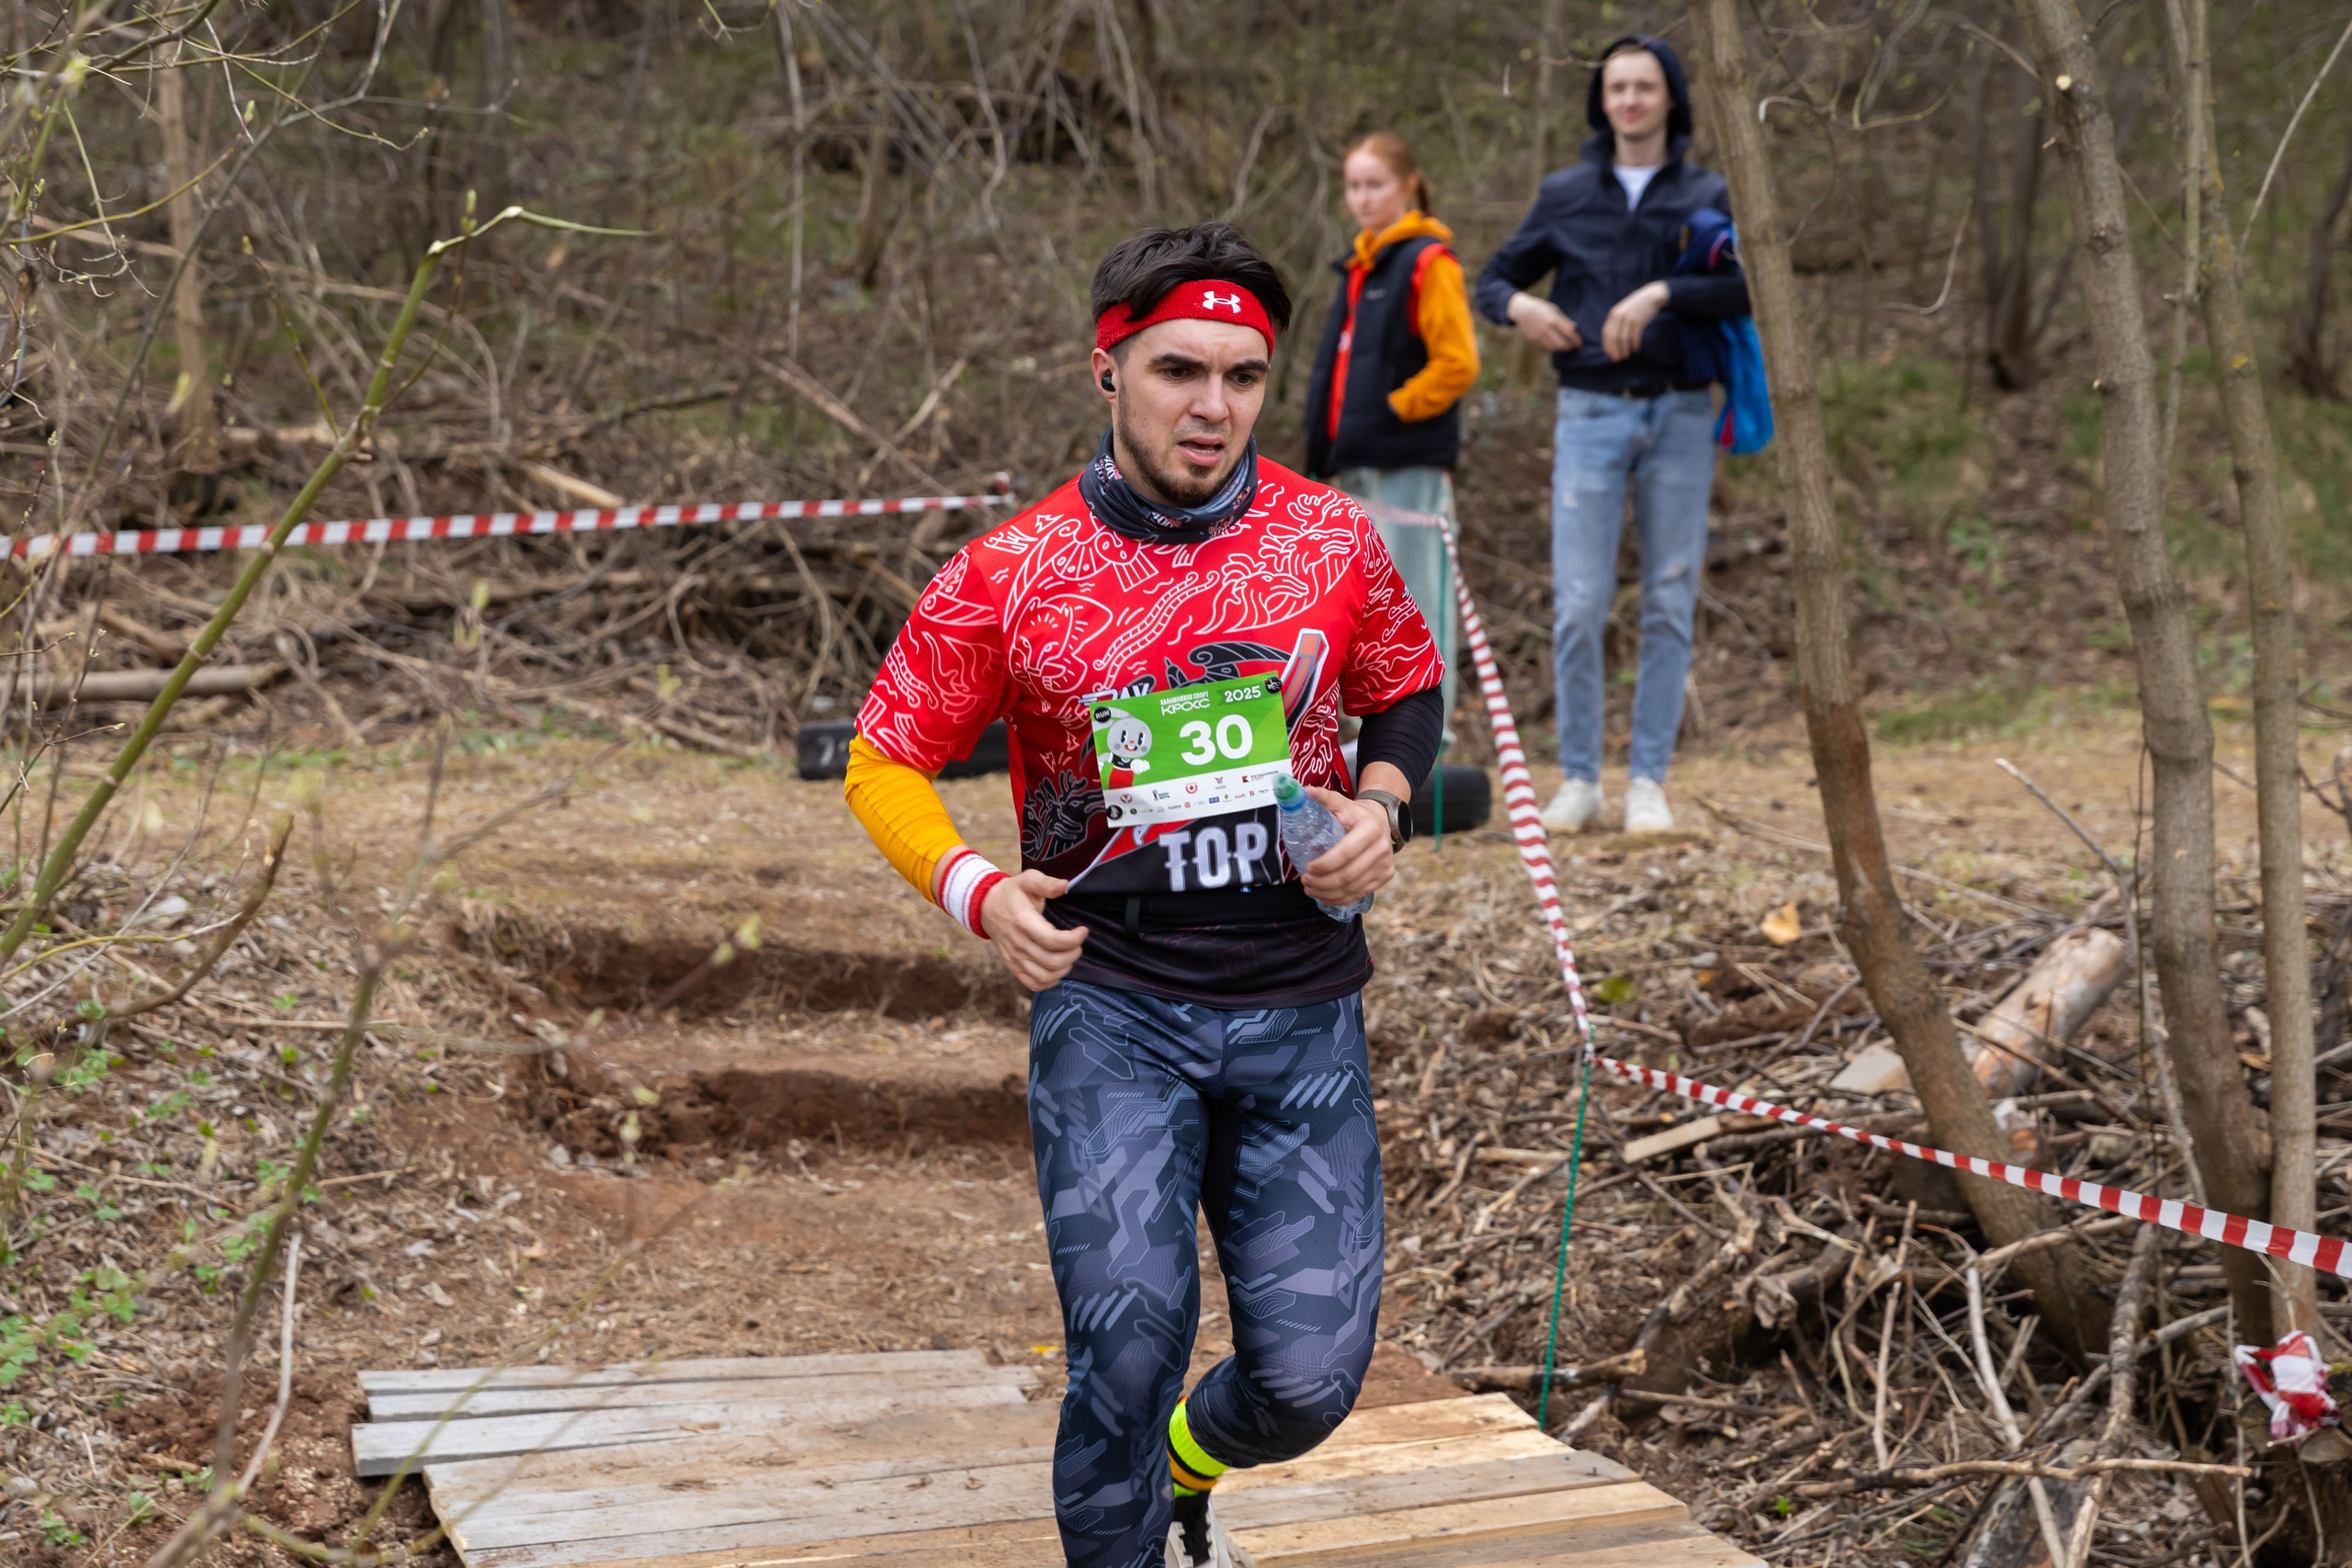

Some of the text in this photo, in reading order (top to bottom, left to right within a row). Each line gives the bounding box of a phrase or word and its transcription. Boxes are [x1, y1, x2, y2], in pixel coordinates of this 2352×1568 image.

[1193, 691, 1209, 701] СПОРТ
[1225, 684, 1262, 703] 2025
[1094, 709, 1110, 719] RUN
[1160, 698, 1211, 716] КРОСС
[1179, 714, 1253, 766] 30
